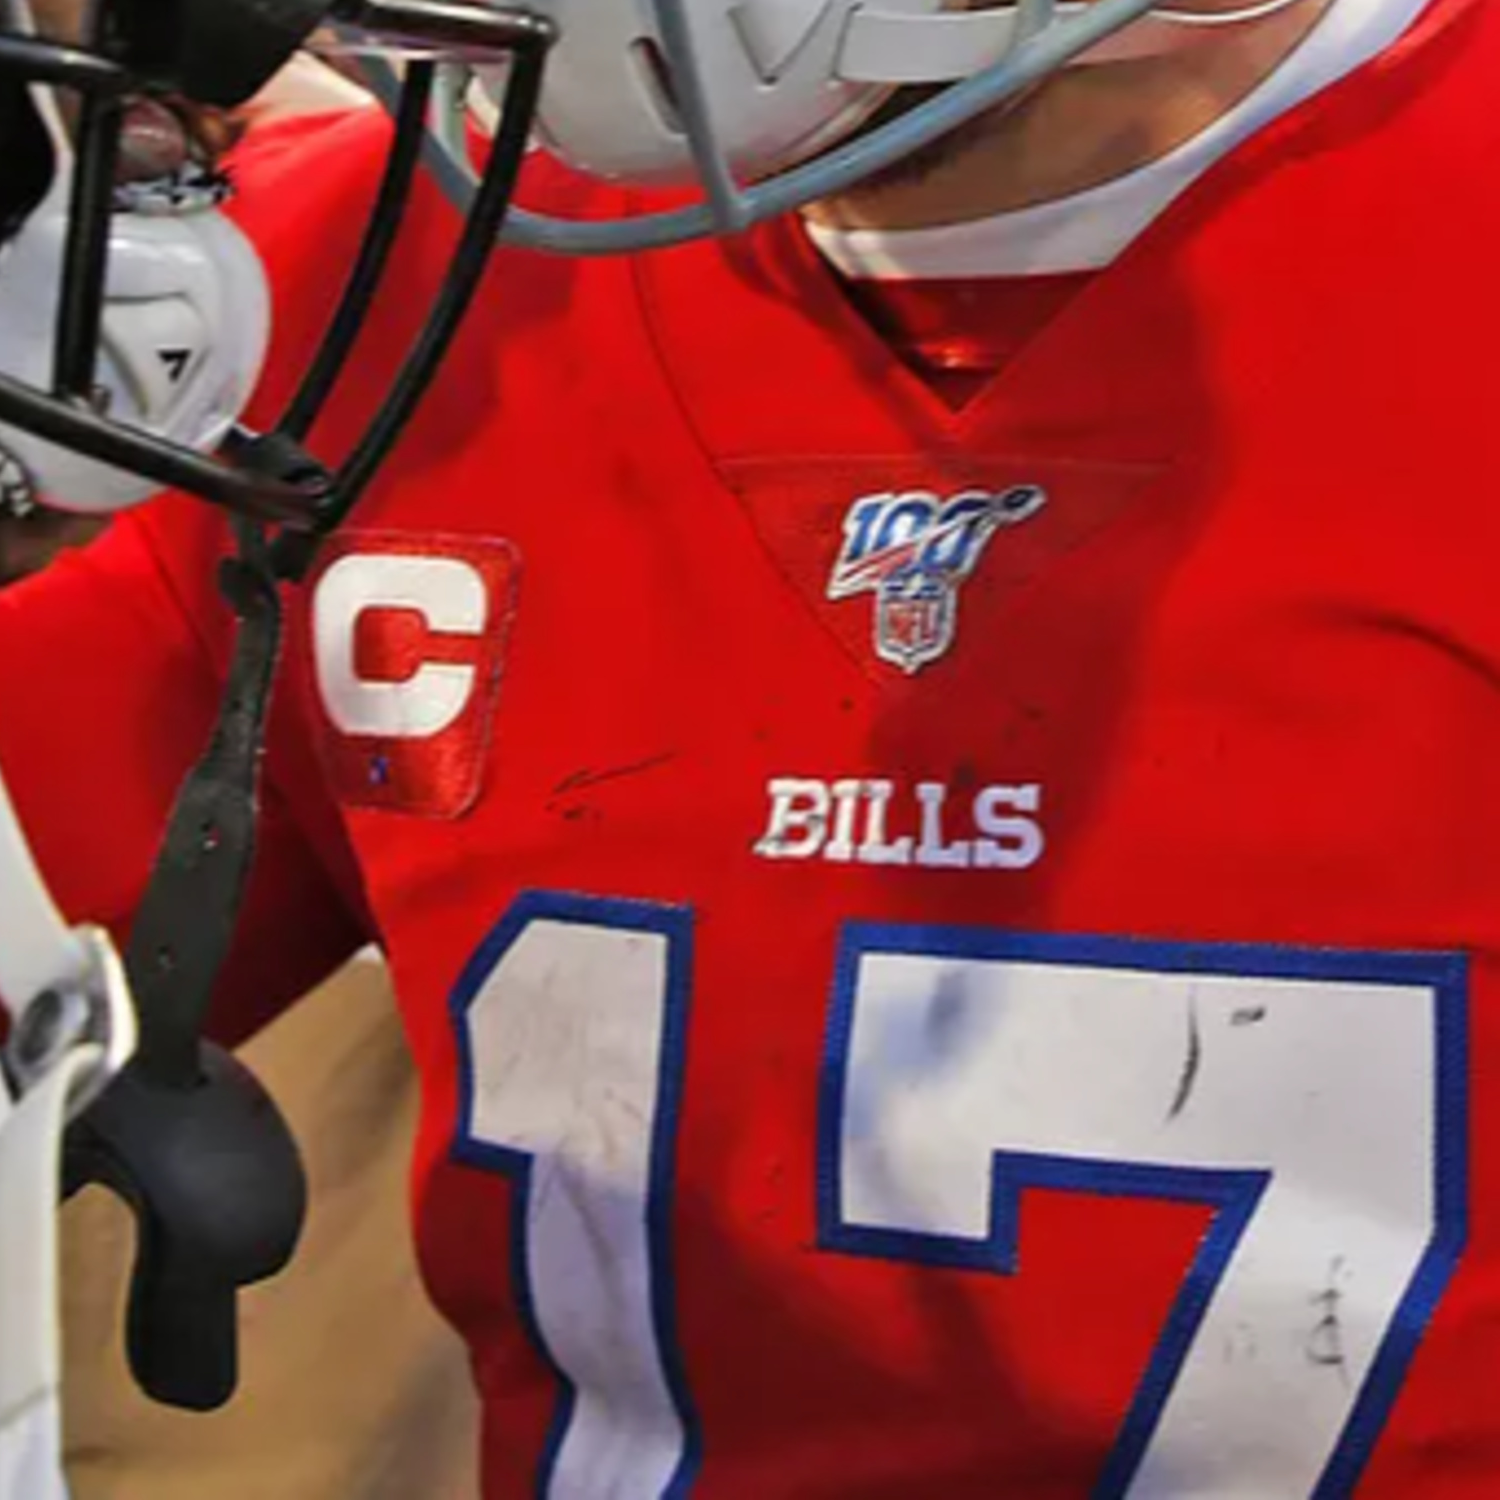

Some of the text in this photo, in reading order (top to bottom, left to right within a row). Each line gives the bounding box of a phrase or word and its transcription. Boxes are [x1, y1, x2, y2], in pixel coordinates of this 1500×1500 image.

[832, 489, 1002, 592] 100
[312, 554, 488, 738] C
[752, 777, 1044, 869] BILLS
[450, 888, 1468, 1500] 17
